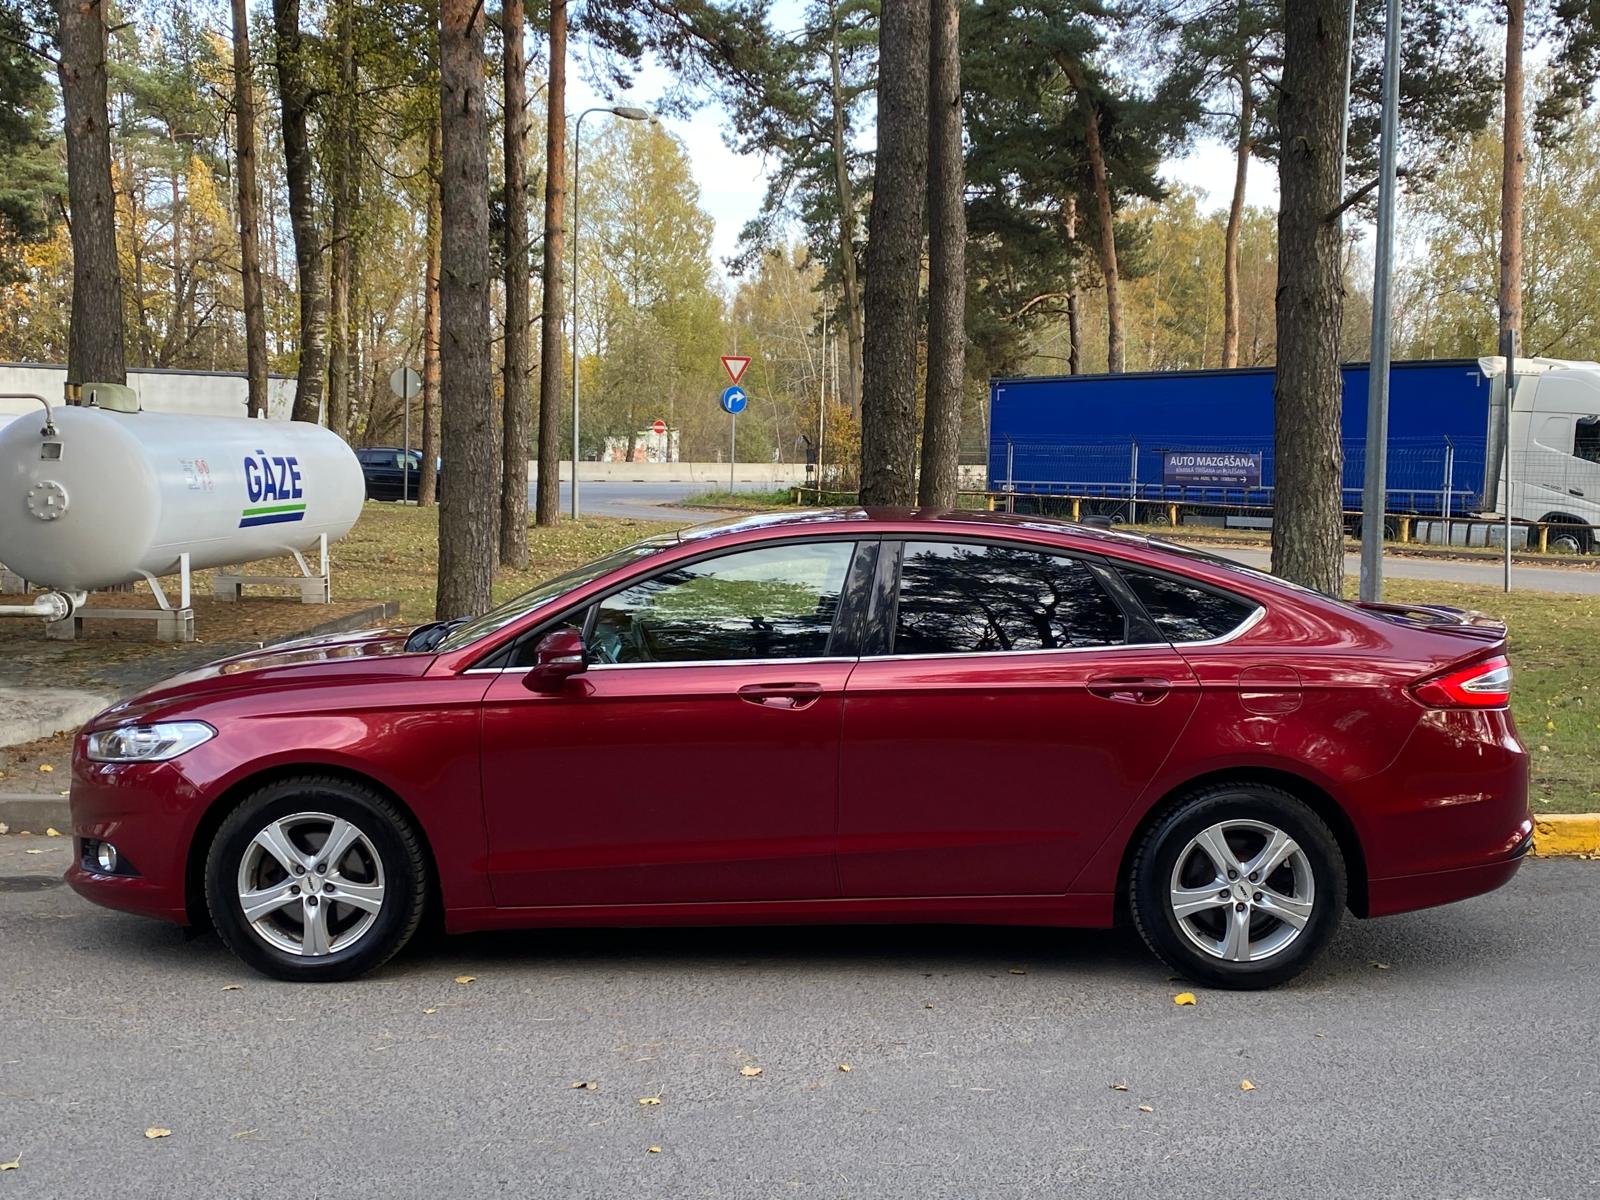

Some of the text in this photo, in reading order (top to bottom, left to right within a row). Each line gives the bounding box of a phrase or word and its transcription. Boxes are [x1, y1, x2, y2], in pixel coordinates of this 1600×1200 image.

[243, 449, 303, 503] GĀZE
[1170, 455, 1255, 468] AUTO MAZGĀŠANA
